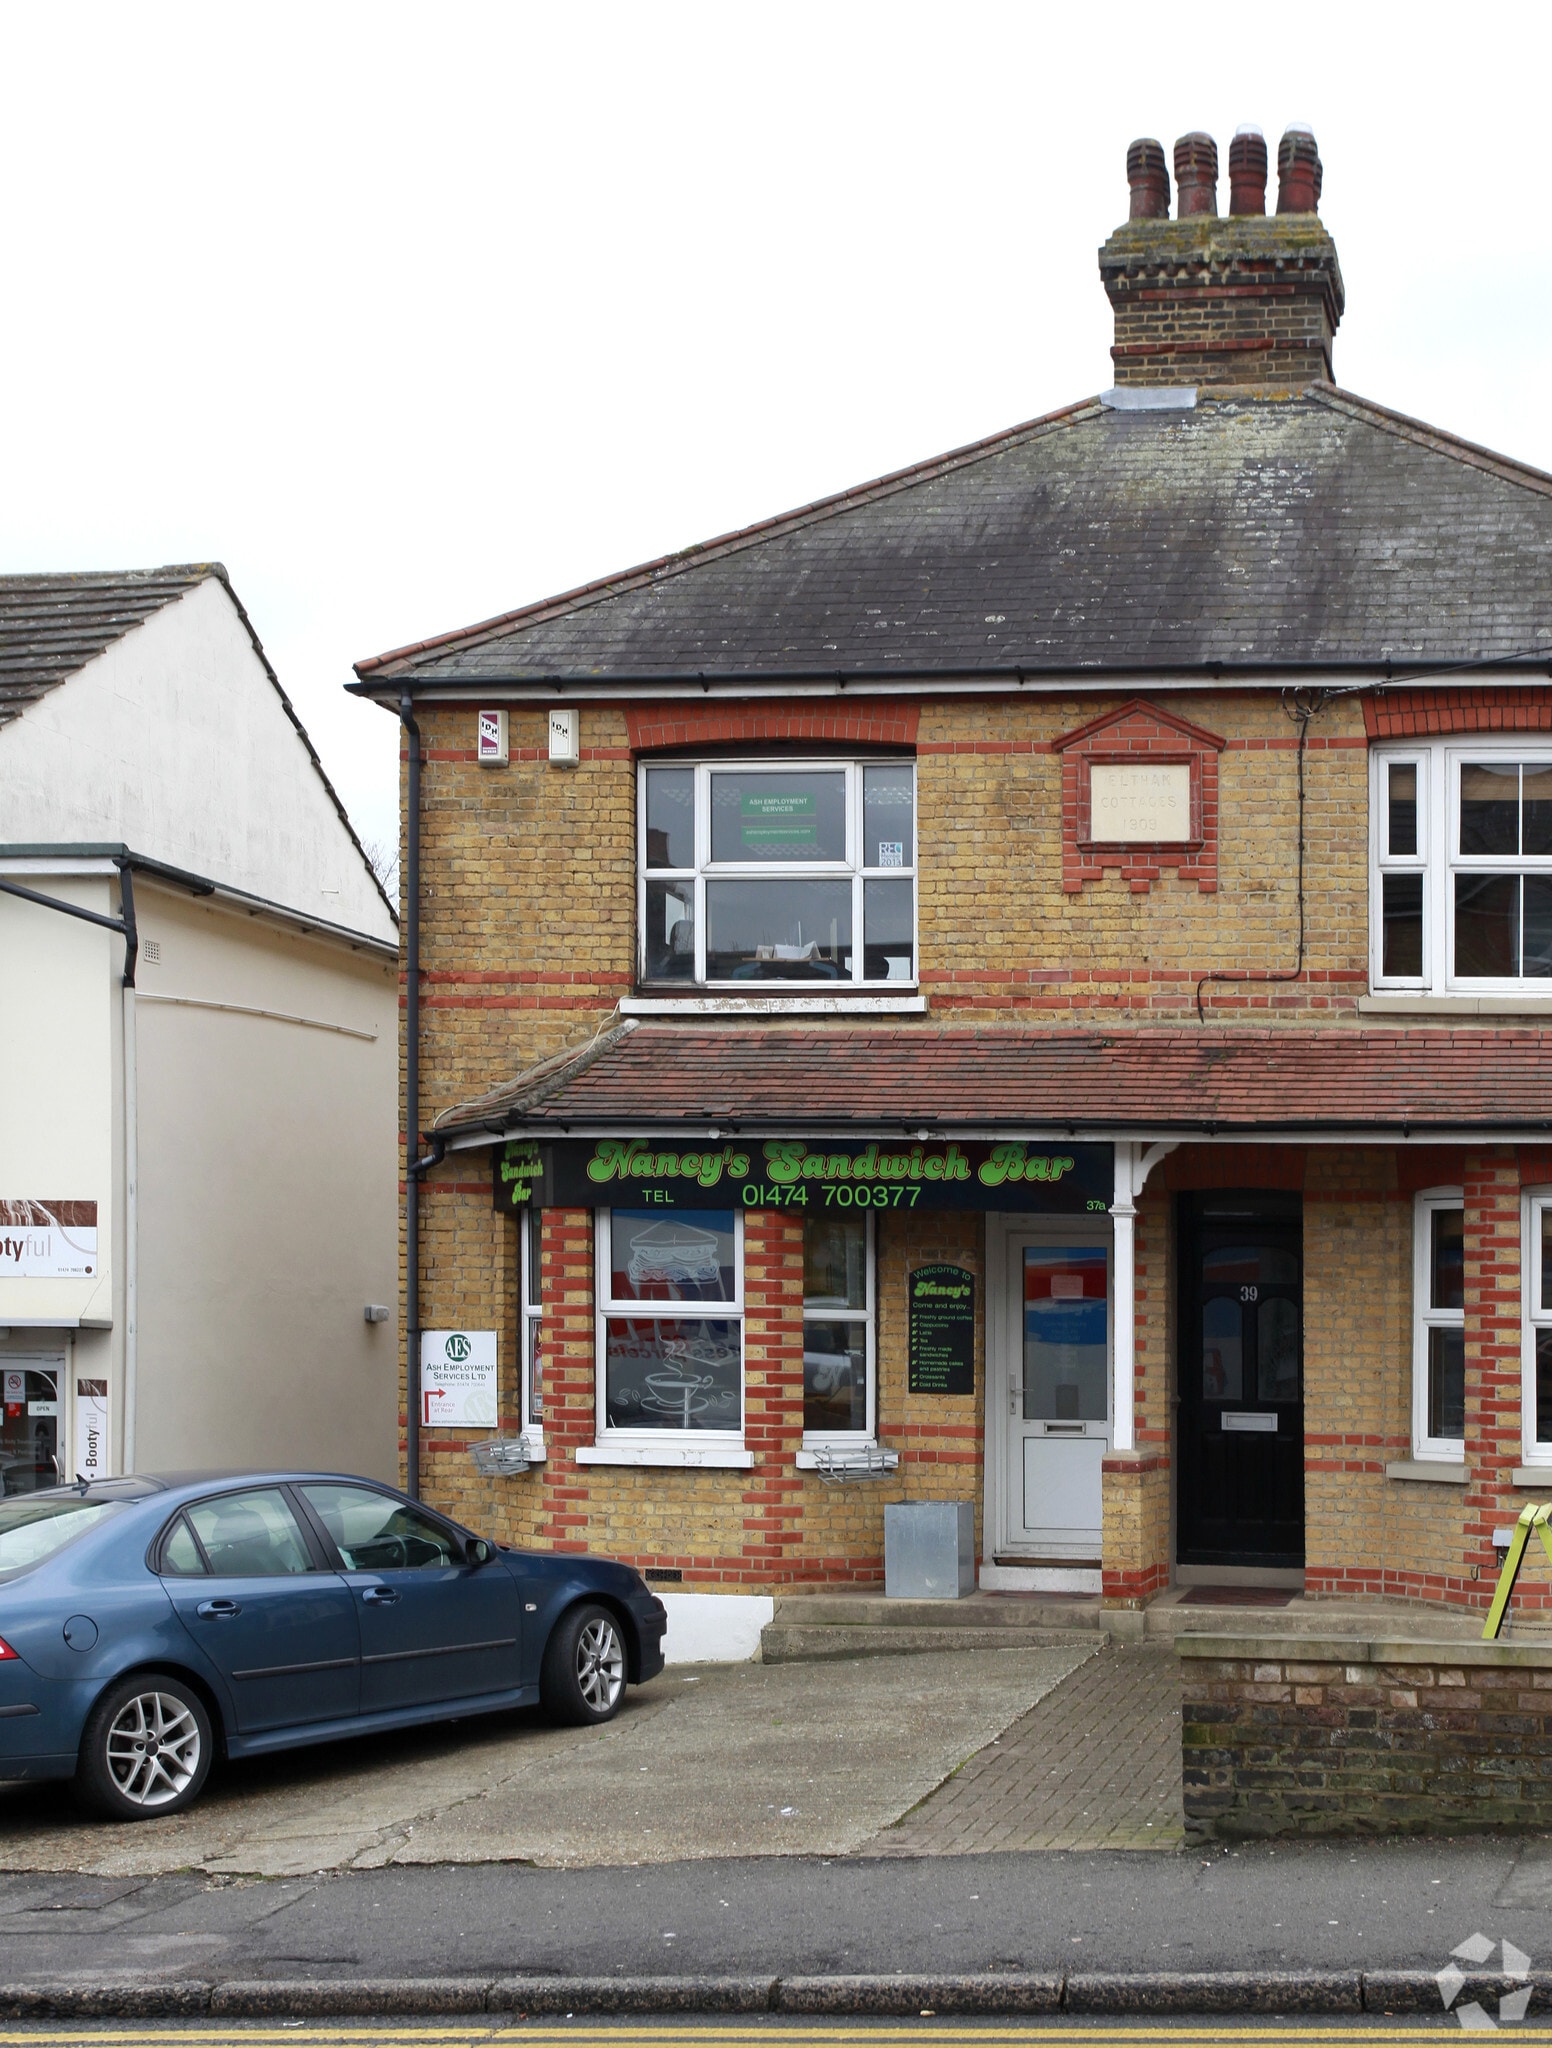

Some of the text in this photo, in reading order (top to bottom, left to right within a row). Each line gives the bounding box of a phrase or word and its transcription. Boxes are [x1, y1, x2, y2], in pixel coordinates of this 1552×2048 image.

[482, 721, 497, 735] IDH
[552, 721, 568, 735] IDH
[1108, 774, 1172, 787] ELTHAM
[761, 805, 794, 813] SERVICES
[763, 797, 808, 806] EMPLOYMENT
[1100, 795, 1178, 809] COTTAGES
[501, 1159, 543, 1182] Sandwich
[587, 1139, 1075, 1187] Nancy's Sandwich Bar
[512, 1180, 532, 1204] Bar
[642, 1184, 922, 1208] TEL 01474 700377
[1086, 1200, 1106, 1211] 37a
[914, 1265, 972, 1281] Welcome to
[914, 1281, 972, 1299] Nancy's
[1240, 1286, 1258, 1301] 39
[446, 1337, 472, 1359] AES
[86, 1413, 100, 1467] Bootyful
